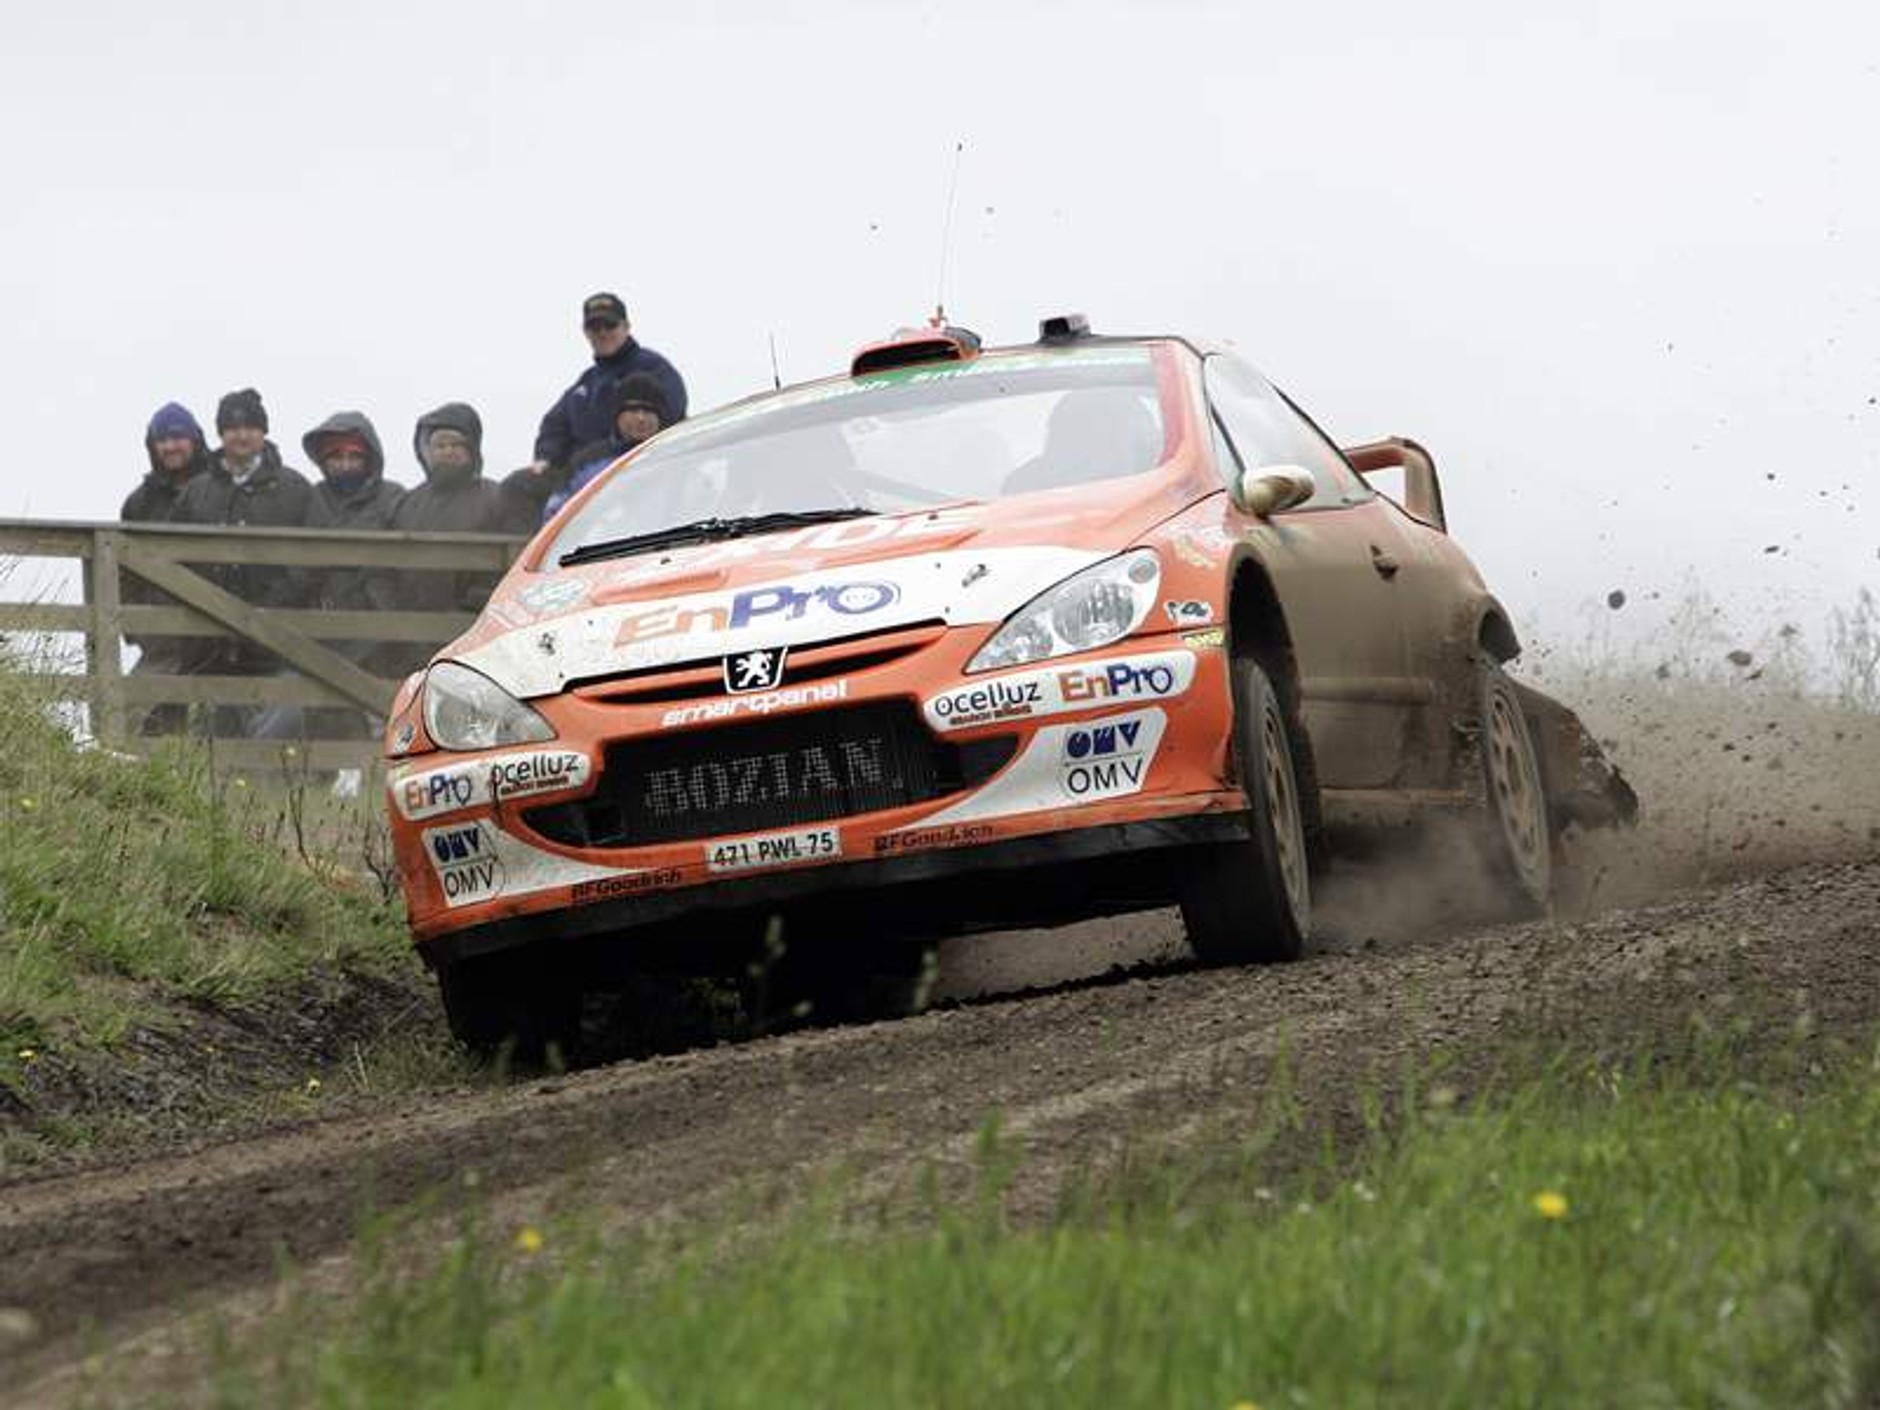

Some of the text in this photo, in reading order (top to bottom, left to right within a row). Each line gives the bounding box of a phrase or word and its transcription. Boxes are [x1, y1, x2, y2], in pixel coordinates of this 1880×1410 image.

[613, 581, 900, 648] EnPro
[935, 681, 1042, 717] ocelluz
[1057, 664, 1174, 701] EnPro
[405, 775, 472, 809] EnPro
[489, 754, 579, 789] ocelluz
[647, 737, 883, 816] BOZIAN
[1066, 758, 1143, 794] OMV
[713, 832, 835, 867] 471 PWL 75
[443, 862, 494, 897] OMV
